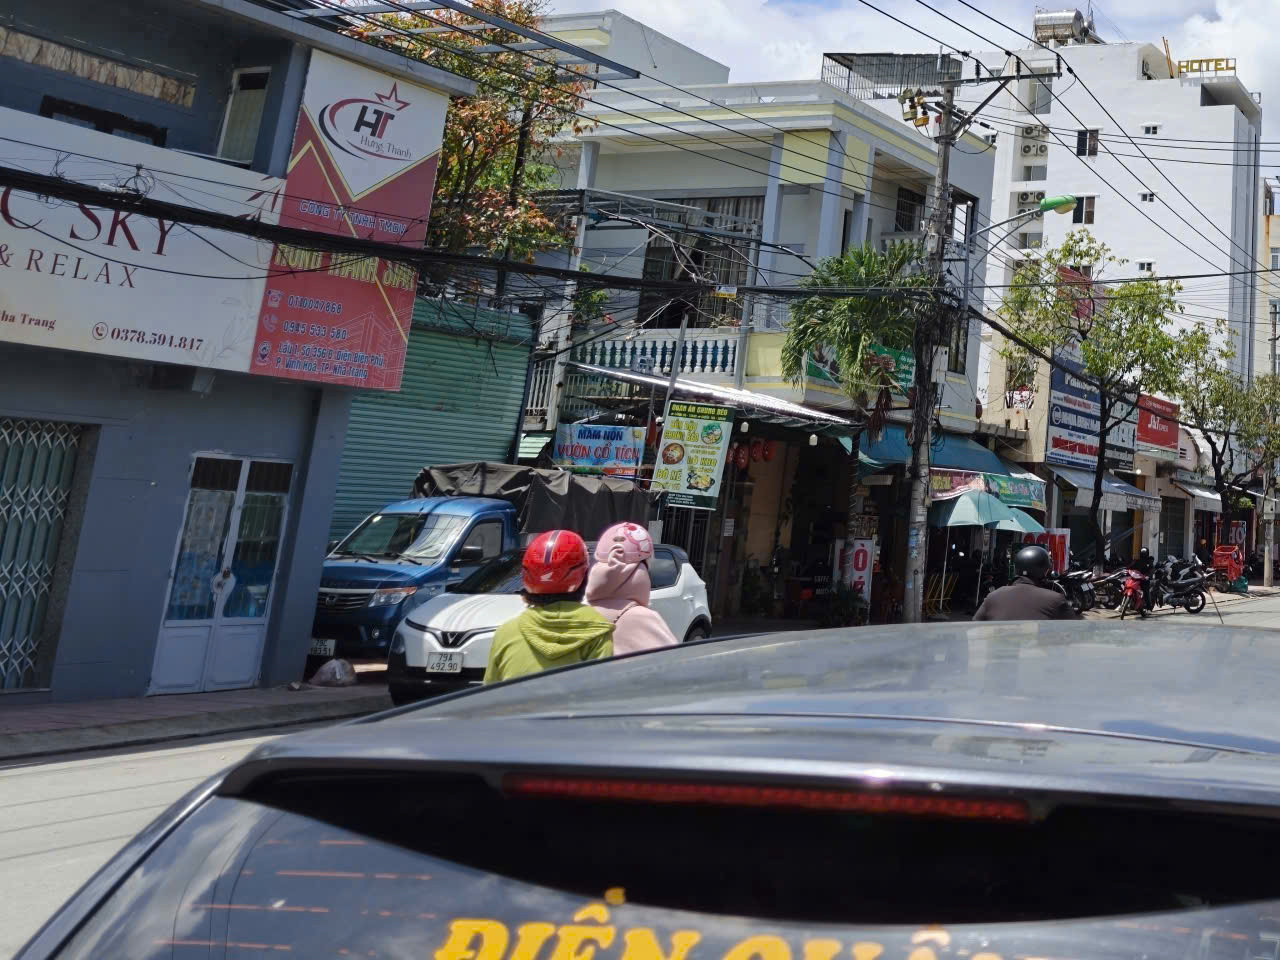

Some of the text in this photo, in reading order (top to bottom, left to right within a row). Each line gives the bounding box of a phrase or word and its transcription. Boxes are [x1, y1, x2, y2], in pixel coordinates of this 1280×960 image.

[1178, 58, 1236, 73] HOTEL
[25, 248, 139, 289] RELAX
[20, 313, 57, 330] Trang
[438, 653, 454, 662] 79A
